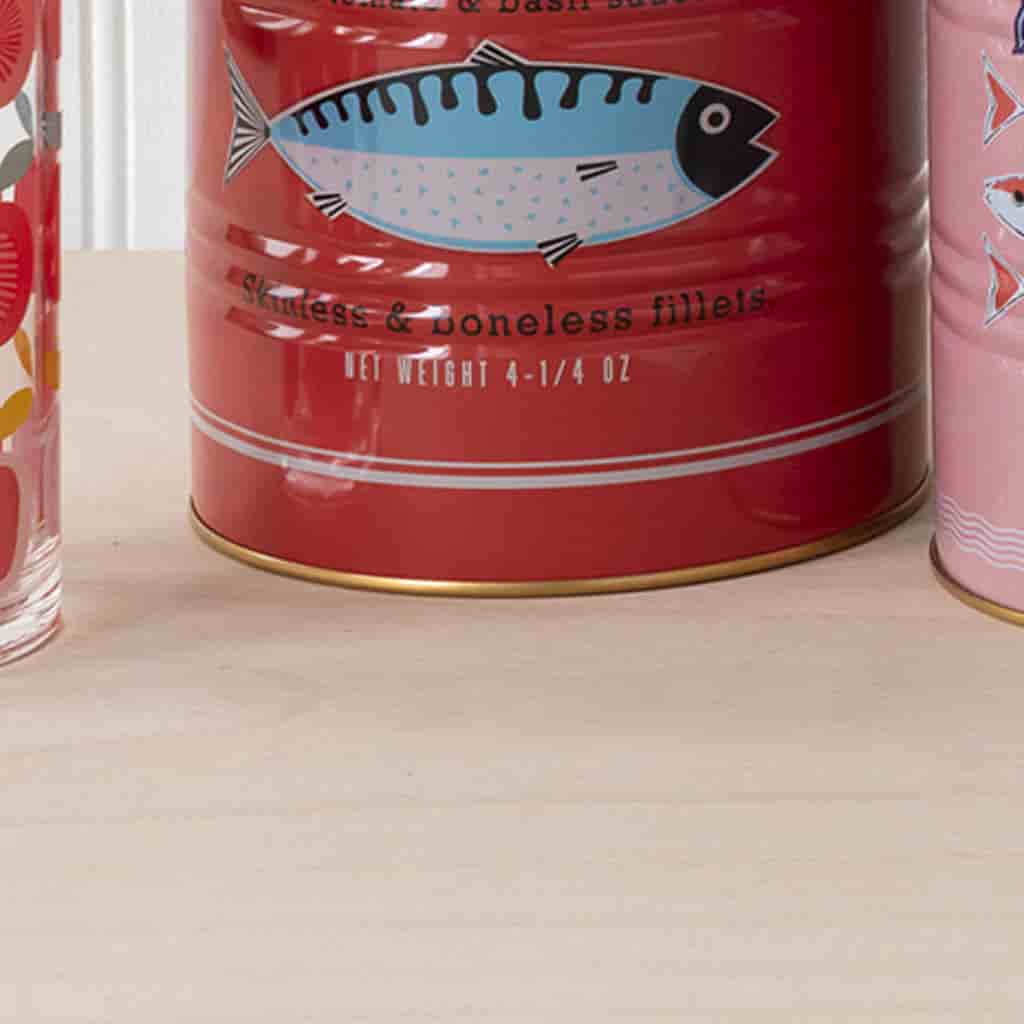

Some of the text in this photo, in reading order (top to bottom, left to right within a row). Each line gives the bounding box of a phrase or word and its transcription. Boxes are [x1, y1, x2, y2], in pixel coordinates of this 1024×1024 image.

[243, 273, 768, 337] Skinless & boneless fillets
[344, 352, 632, 389] NET WEIGHT 4-1/4 OZ
